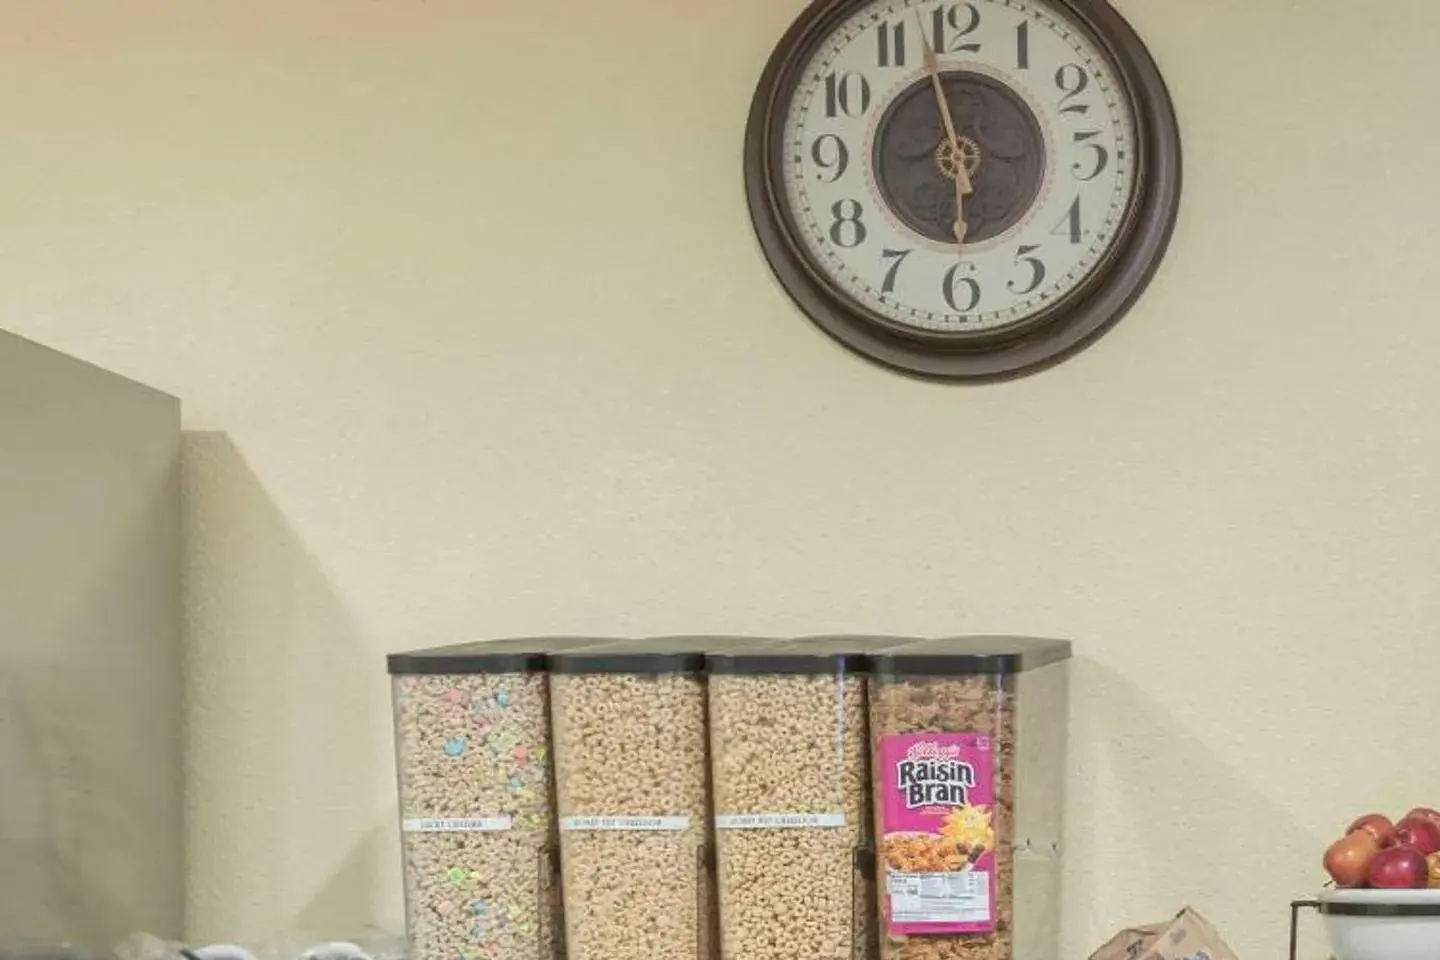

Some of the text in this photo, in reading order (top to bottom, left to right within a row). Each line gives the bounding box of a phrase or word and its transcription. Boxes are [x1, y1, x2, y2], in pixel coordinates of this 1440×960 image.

[877, 19, 905, 67] 11
[932, 3, 981, 54] 12
[1014, 19, 1029, 70] 1
[824, 69, 871, 118] 10
[1054, 63, 1089, 114] 2
[811, 134, 849, 183] 9
[829, 199, 866, 248] 8
[1049, 192, 1083, 244] 4
[880, 248, 913, 293] 7
[942, 261, 981, 312] 6
[1005, 244, 1046, 294] 5
[899, 761, 973, 786] Raisin
[909, 783, 965, 805] Bran
